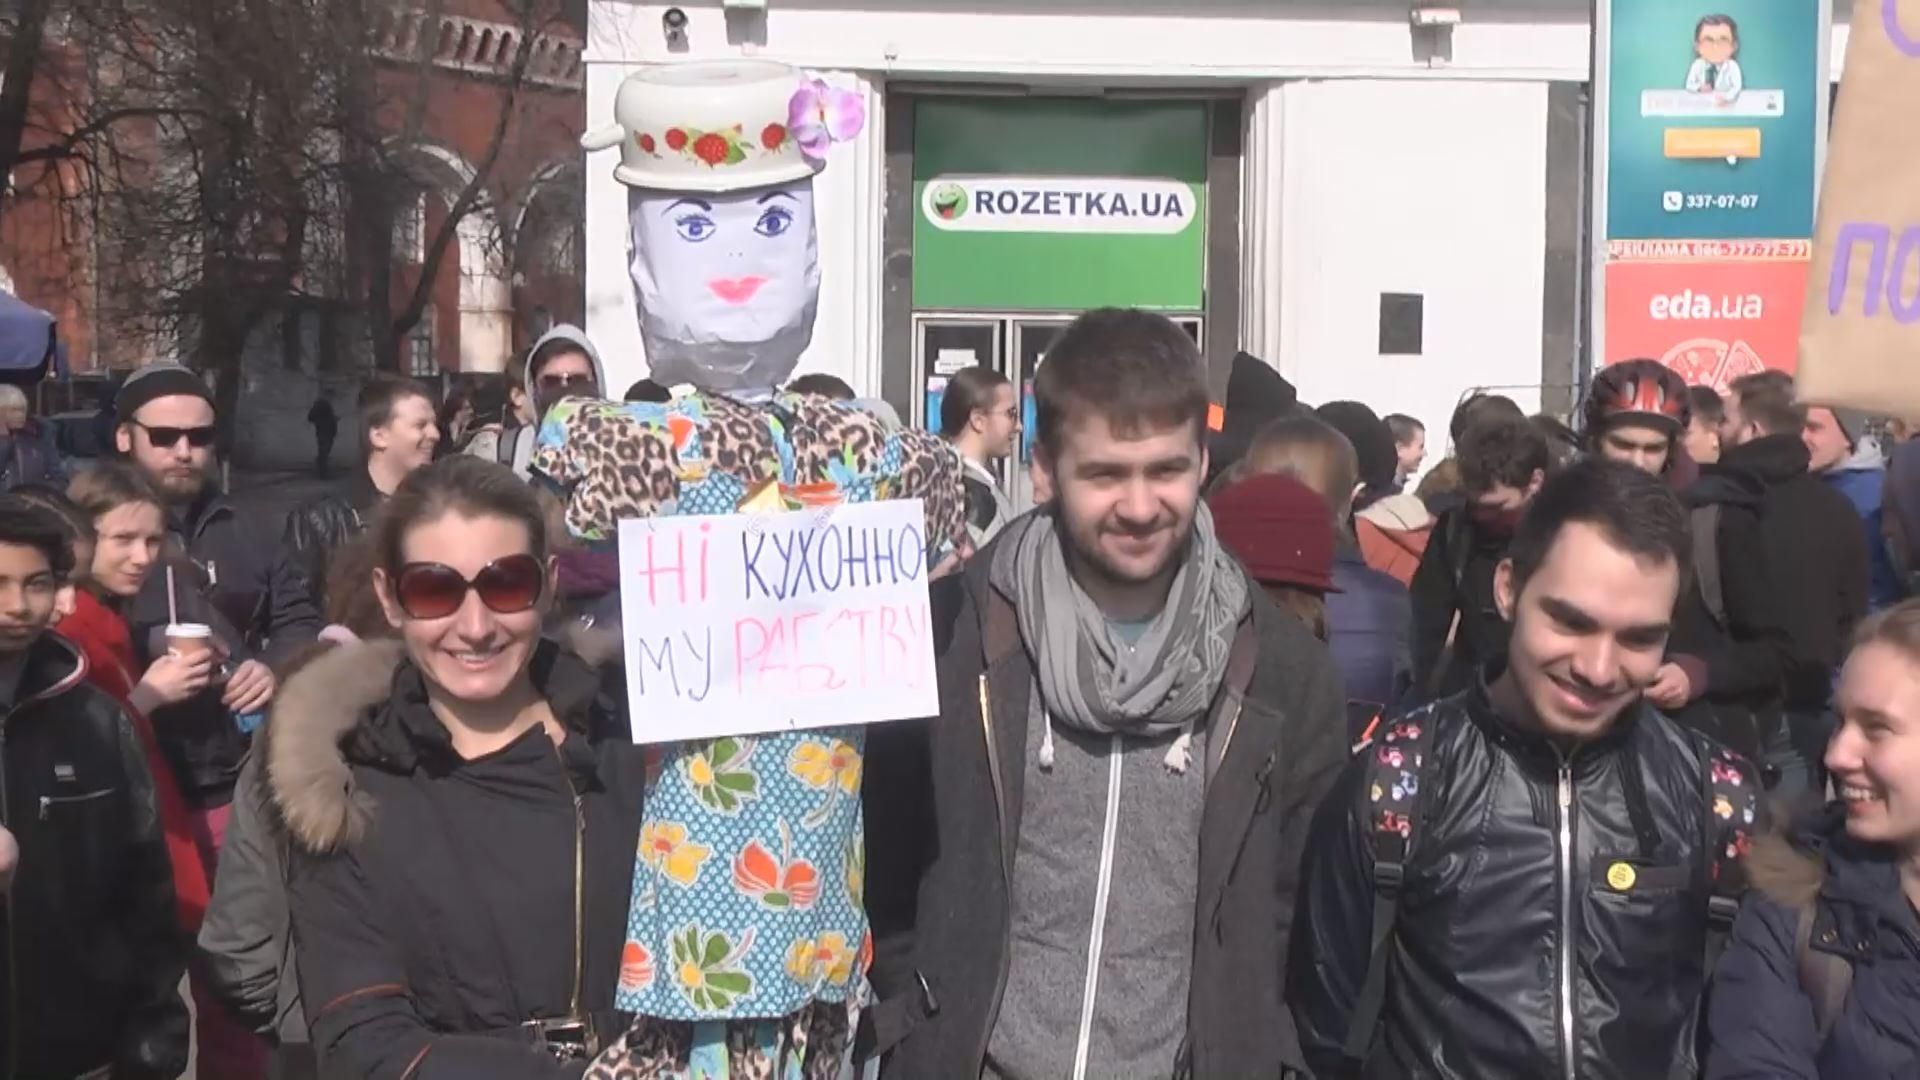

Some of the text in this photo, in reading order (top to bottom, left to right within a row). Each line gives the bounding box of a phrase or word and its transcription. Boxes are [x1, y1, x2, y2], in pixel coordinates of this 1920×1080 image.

[974, 189, 1184, 218] ROZETKA.UA
[1685, 194, 1759, 209] 337-07-07
[1649, 289, 1763, 320] eda.ua
[638, 625, 712, 702] МУ
